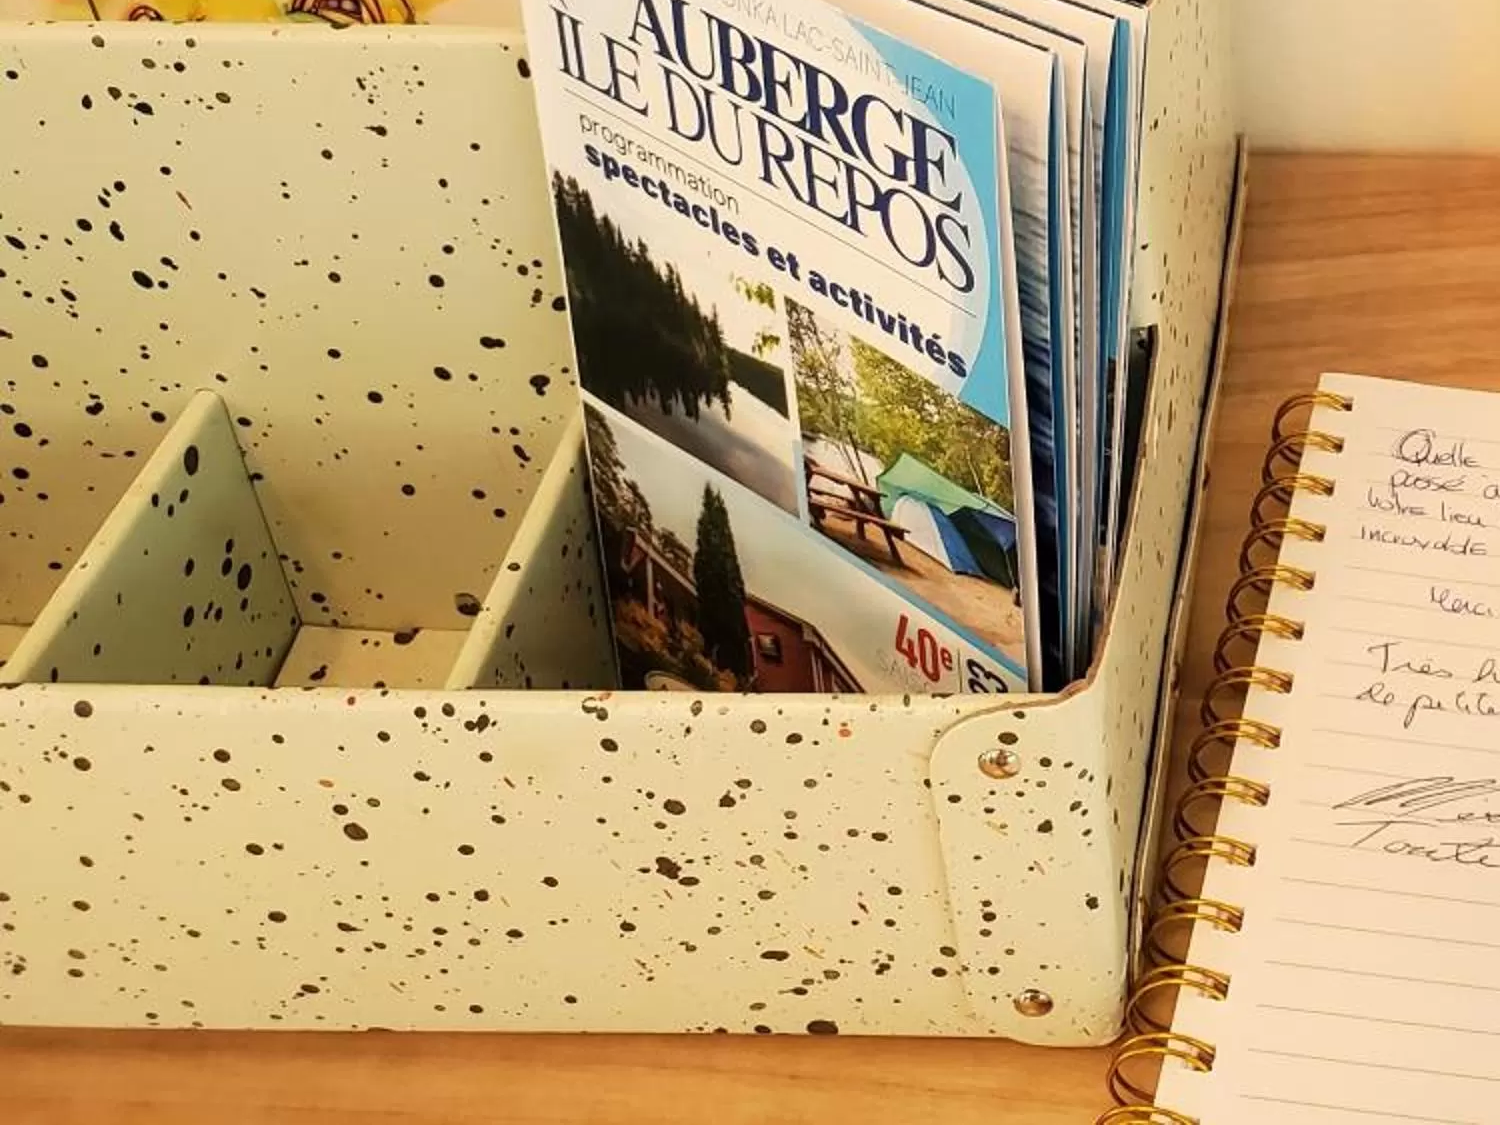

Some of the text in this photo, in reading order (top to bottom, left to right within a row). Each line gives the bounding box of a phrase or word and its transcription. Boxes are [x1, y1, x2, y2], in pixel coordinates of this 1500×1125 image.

[579, 113, 741, 216] programmation
[658, 63, 745, 168] DU
[751, 109, 976, 296] REPOS
[584, 142, 969, 377] spectacles et activités
[896, 613, 953, 683] 40e
